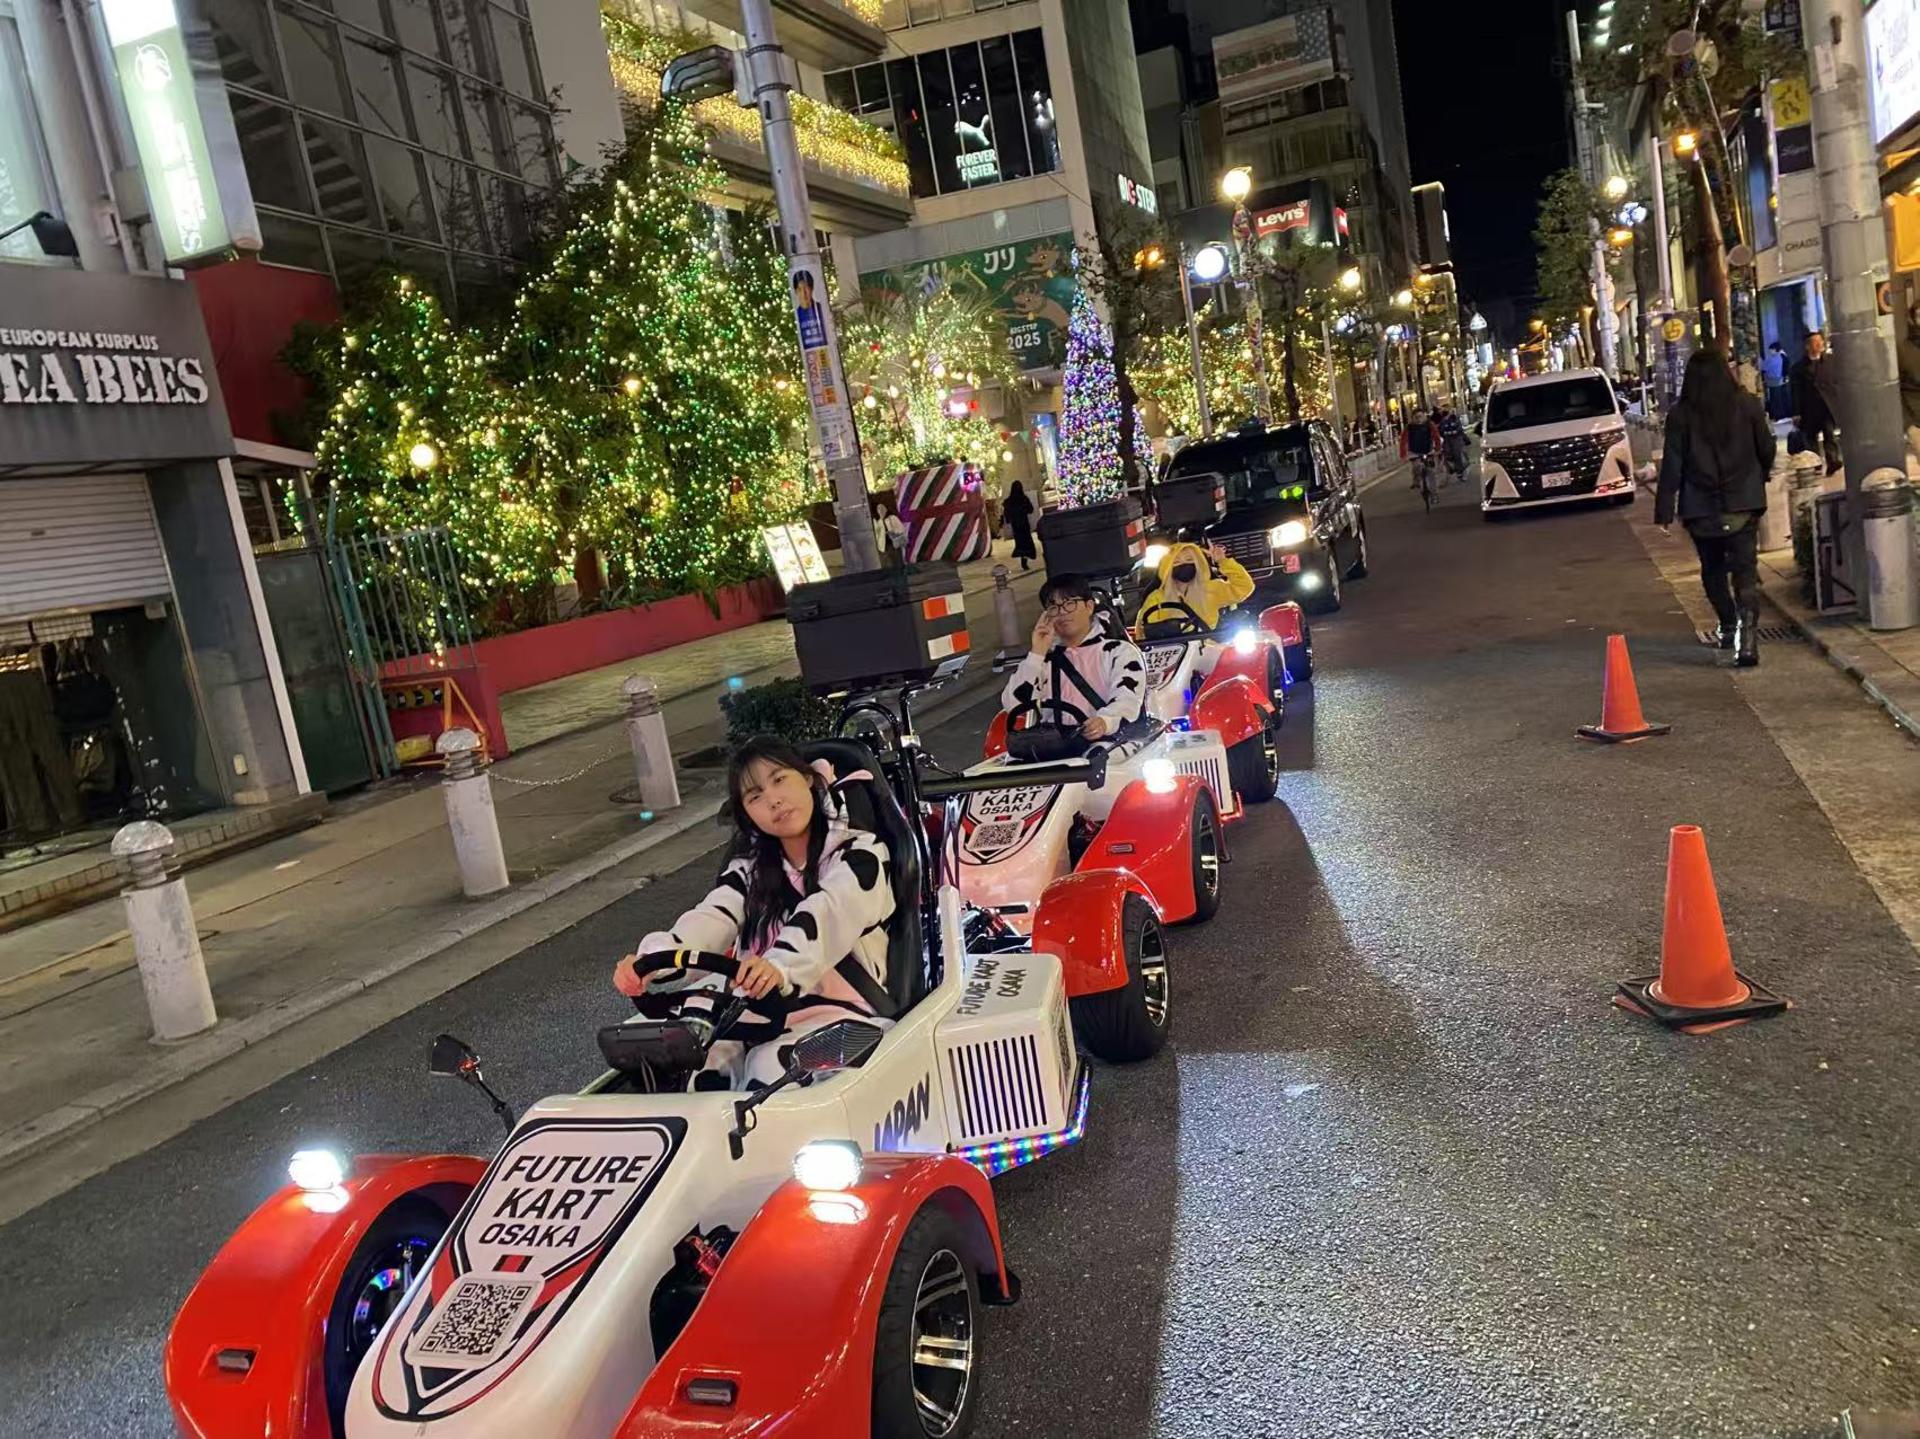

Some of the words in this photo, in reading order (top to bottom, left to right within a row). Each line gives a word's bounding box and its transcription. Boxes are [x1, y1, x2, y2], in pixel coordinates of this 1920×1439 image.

[0, 327, 92, 348] EUROPEAN
[94, 333, 159, 350] SURPLUS
[1006, 331, 1041, 350] 2025
[75, 354, 208, 404] BEES
[979, 802, 1033, 815] OSAKA
[981, 790, 1042, 806] KART
[971, 958, 1000, 980] KART
[996, 969, 1028, 997] OSAKA
[956, 981, 991, 1015] FUTURE
[501, 1155, 652, 1184] FUTURE
[492, 1187, 616, 1220] KART
[478, 1223, 581, 1248] OSAKA
